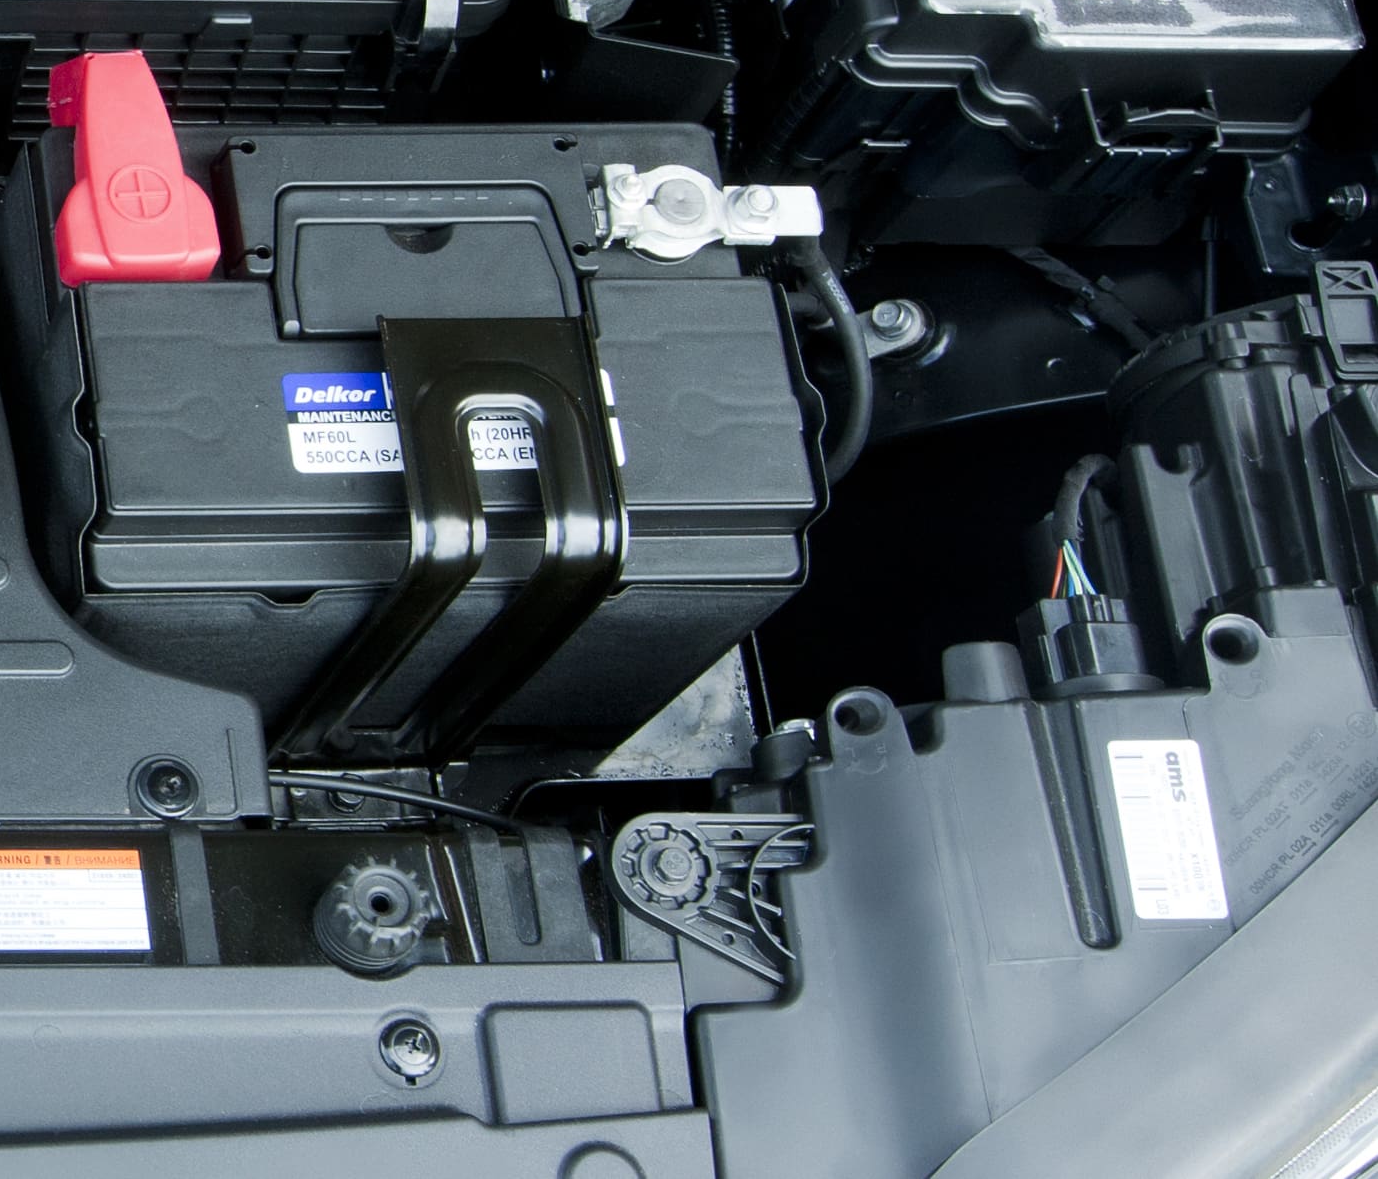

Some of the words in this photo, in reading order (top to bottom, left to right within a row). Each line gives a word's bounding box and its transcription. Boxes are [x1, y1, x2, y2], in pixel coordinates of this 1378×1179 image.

[294, 385, 376, 404] Delkor
[298, 410, 395, 423] MAINTENANC
[303, 430, 357, 444] MF60L
[307, 450, 371, 464] 550CCA
[1165, 751, 1187, 803] ams
[74, 855, 136, 866] ВНИМАНИЕ
